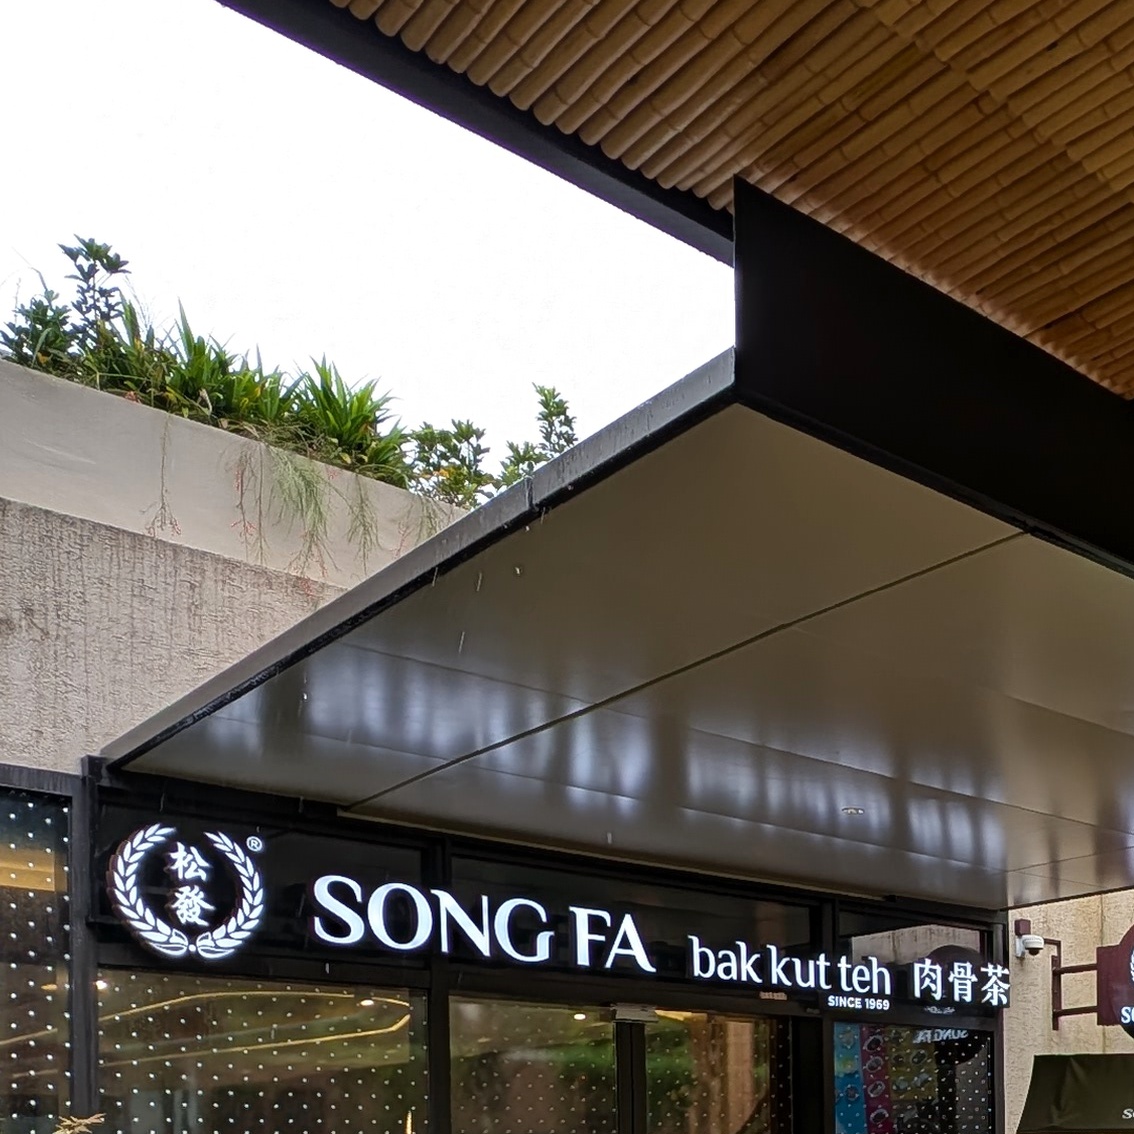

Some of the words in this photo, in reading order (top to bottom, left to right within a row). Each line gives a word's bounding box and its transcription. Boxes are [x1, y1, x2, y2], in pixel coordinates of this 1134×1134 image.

[169, 841, 211, 927] 松發
[313, 874, 554, 963] SONG
[568, 906, 657, 973] FA
[688, 935, 763, 985] bak
[766, 944, 832, 990] kut
[837, 954, 892, 995] teh
[913, 958, 1011, 1006] 肉骨茶
[828, 995, 863, 1010] SINCE
[865, 997, 891, 1011] 1969
